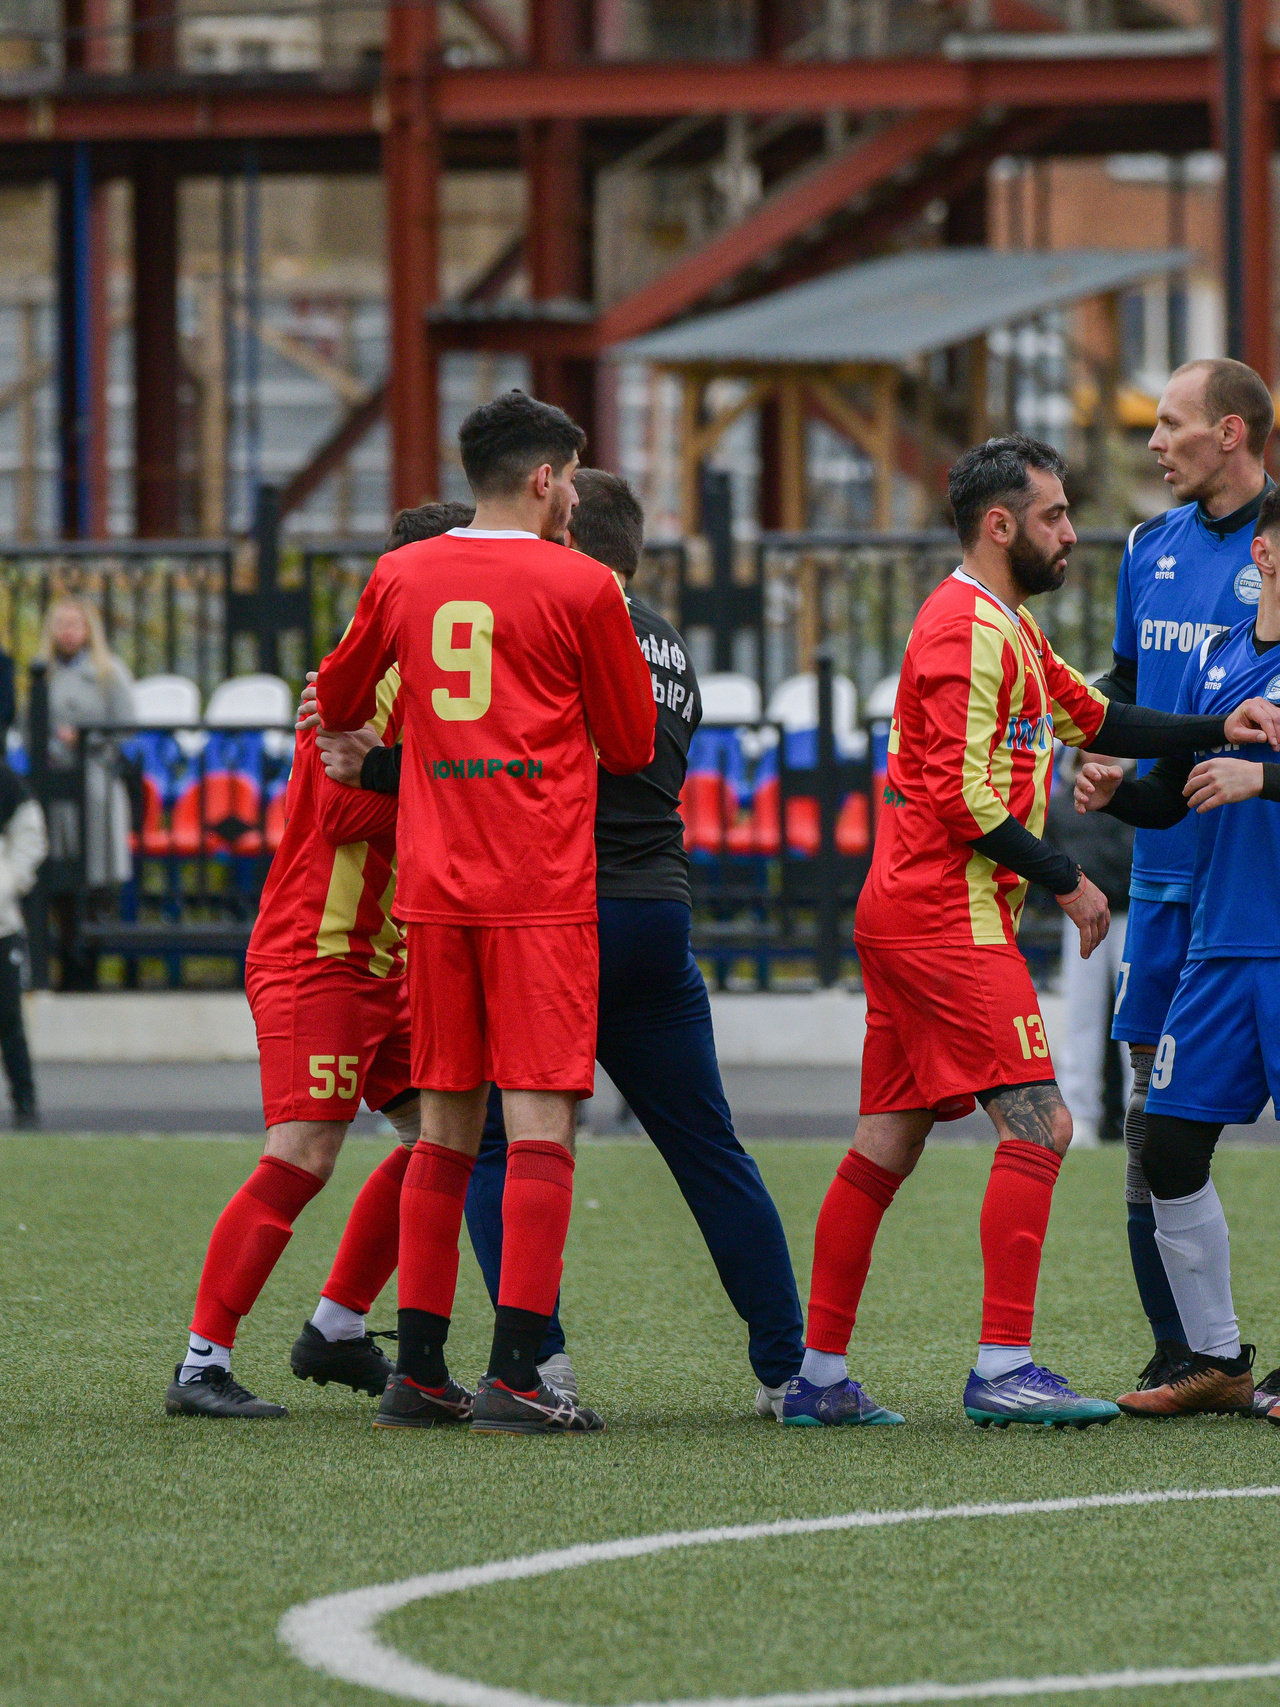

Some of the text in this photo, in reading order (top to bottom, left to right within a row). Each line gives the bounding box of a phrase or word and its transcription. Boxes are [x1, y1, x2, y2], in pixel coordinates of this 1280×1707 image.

[1155, 570, 1175, 580] errea
[1140, 619, 1232, 653] СТРОИТ
[431, 600, 494, 721] 9
[432, 758, 543, 780] ЮНИРОН
[1012, 1014, 1049, 1060] 13
[309, 1055, 359, 1100] 55
[1152, 1034, 1176, 1090] 9
